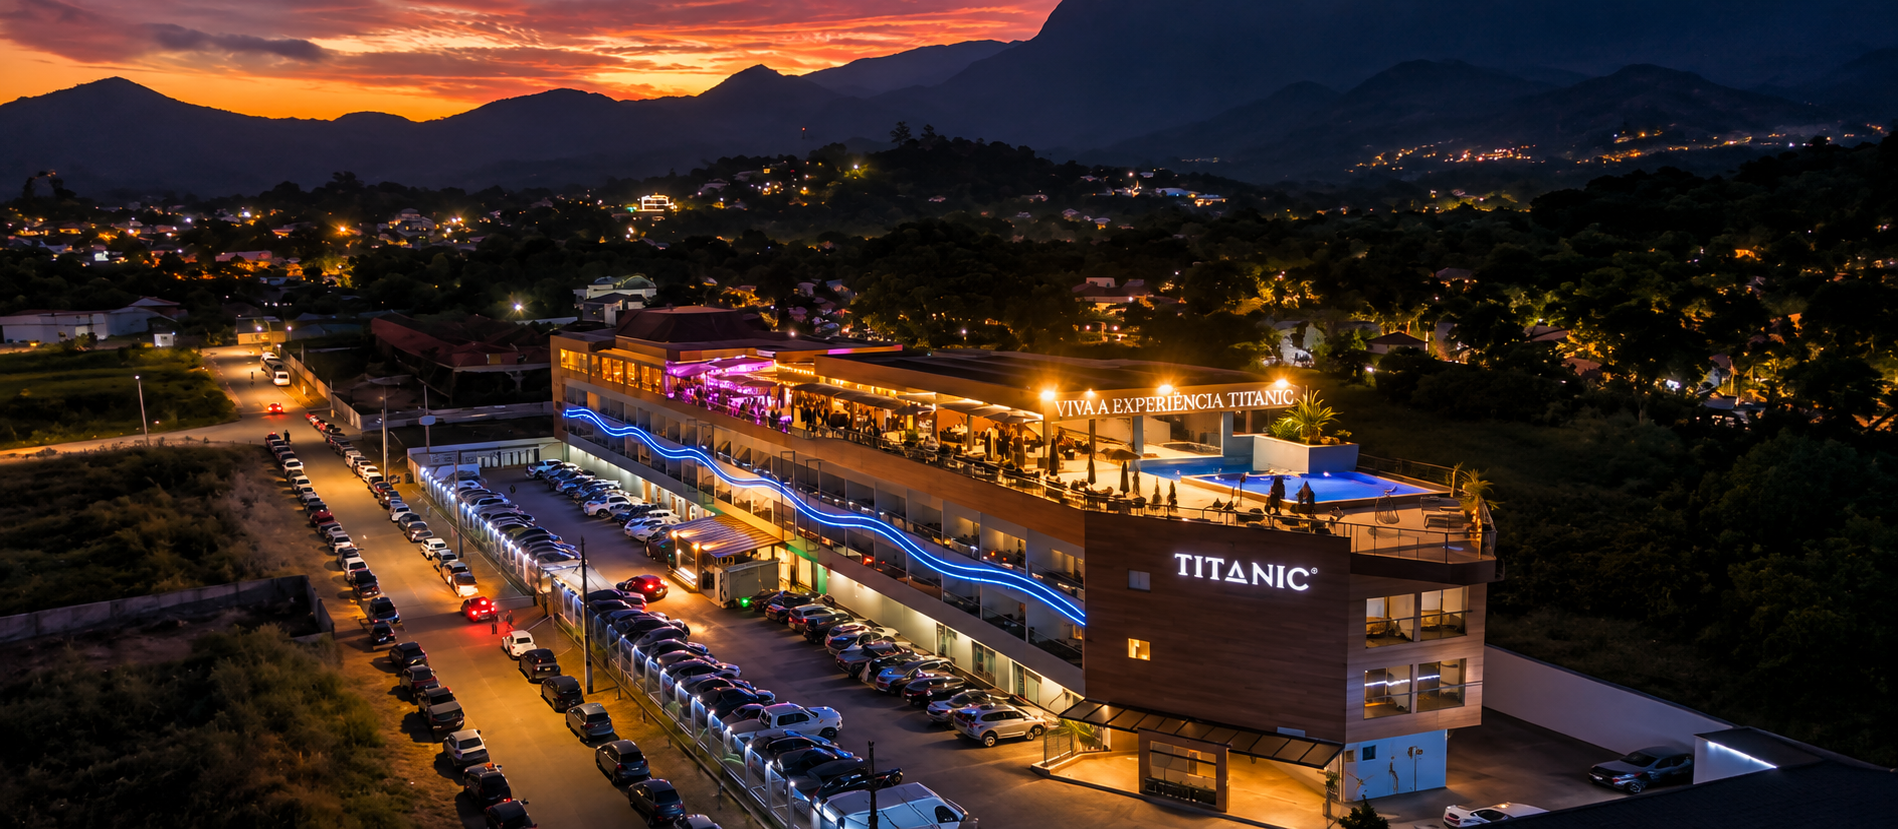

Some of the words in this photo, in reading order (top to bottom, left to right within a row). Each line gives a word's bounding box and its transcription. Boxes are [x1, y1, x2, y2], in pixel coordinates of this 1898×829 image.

[1055, 400, 1095, 417] VIVA
[1098, 399, 1109, 415] A
[1227, 389, 1294, 407] TITANIC
